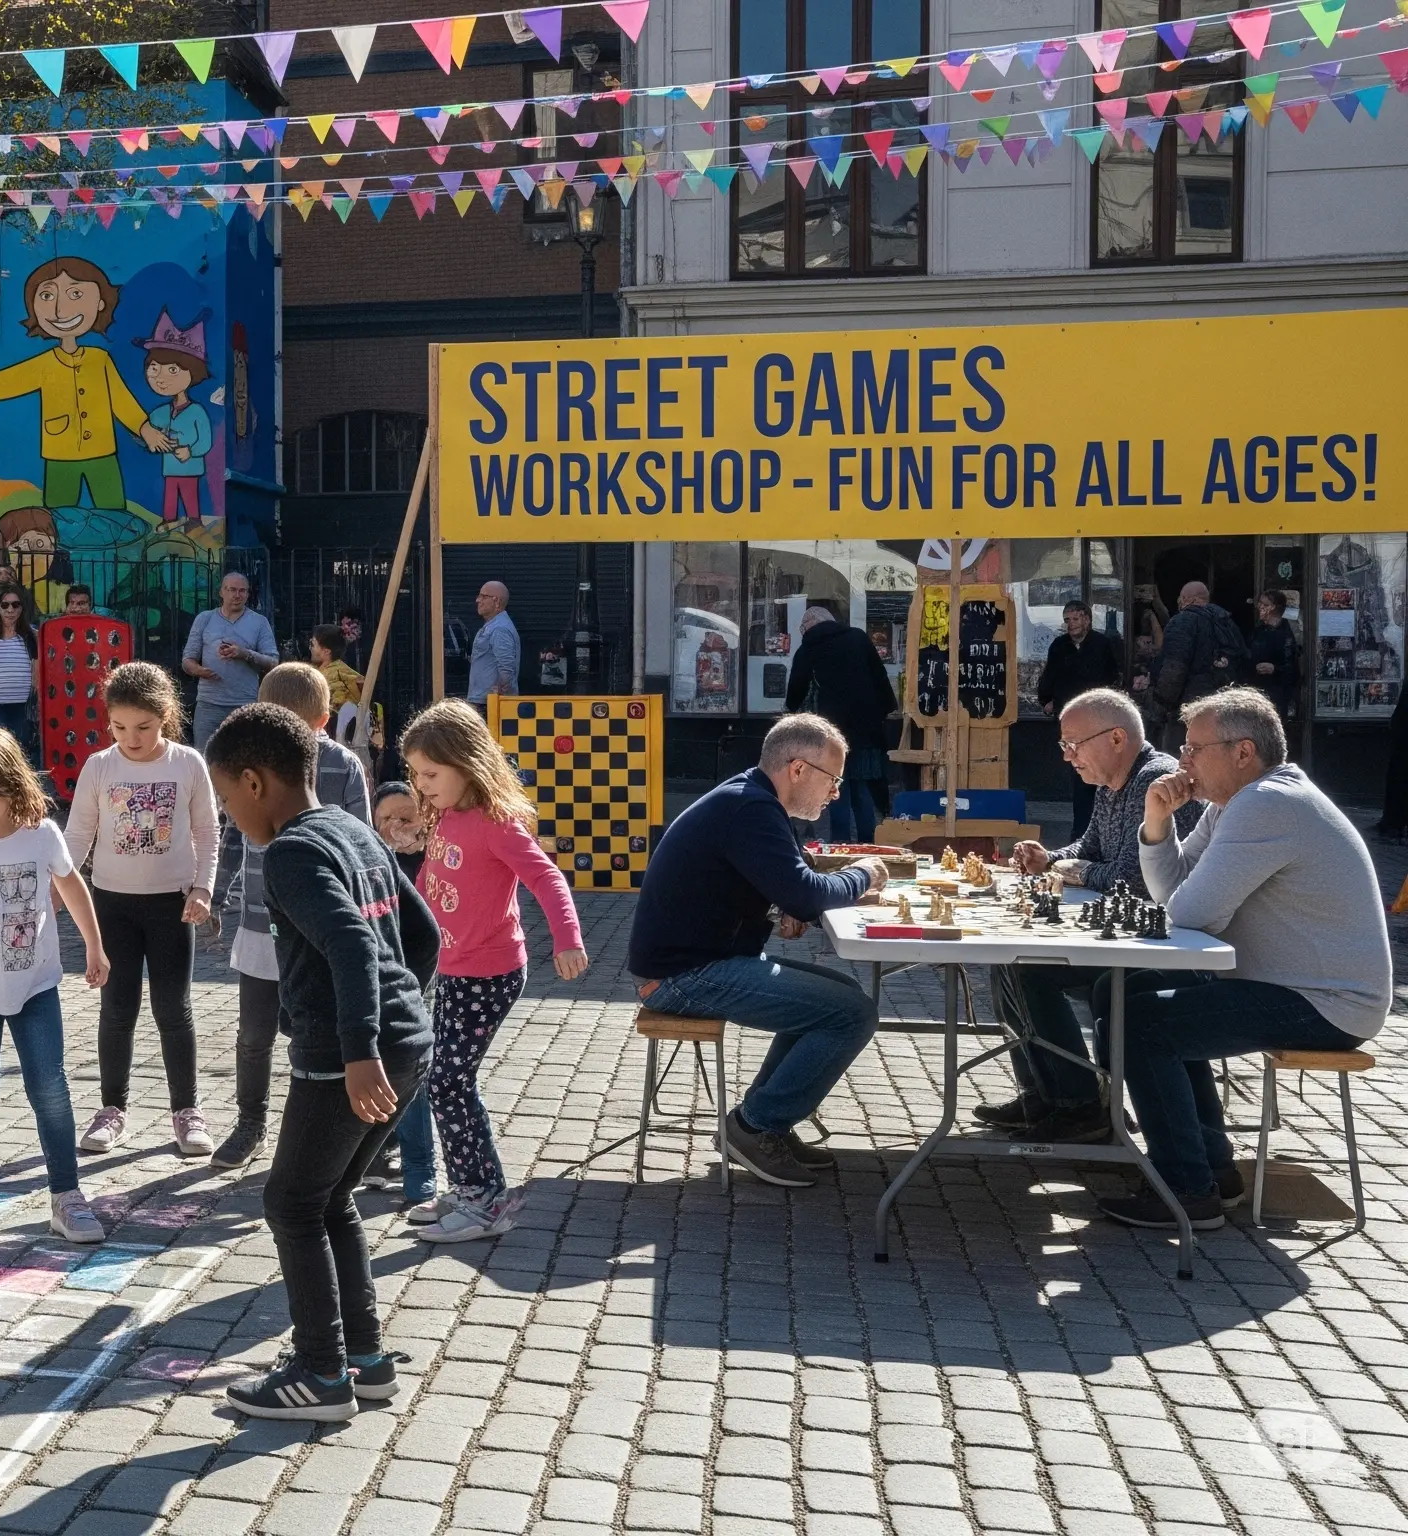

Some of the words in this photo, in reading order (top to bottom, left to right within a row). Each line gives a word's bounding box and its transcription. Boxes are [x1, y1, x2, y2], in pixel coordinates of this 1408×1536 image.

[470, 355, 728, 444] STREET
[754, 346, 1005, 438] GAMES
[470, 449, 781, 516] WORKSHOP
[829, 446, 933, 511] FUN
[952, 443, 1056, 509] FOR
[1076, 440, 1182, 506] ALL
[1202, 434, 1378, 505] AGES!
